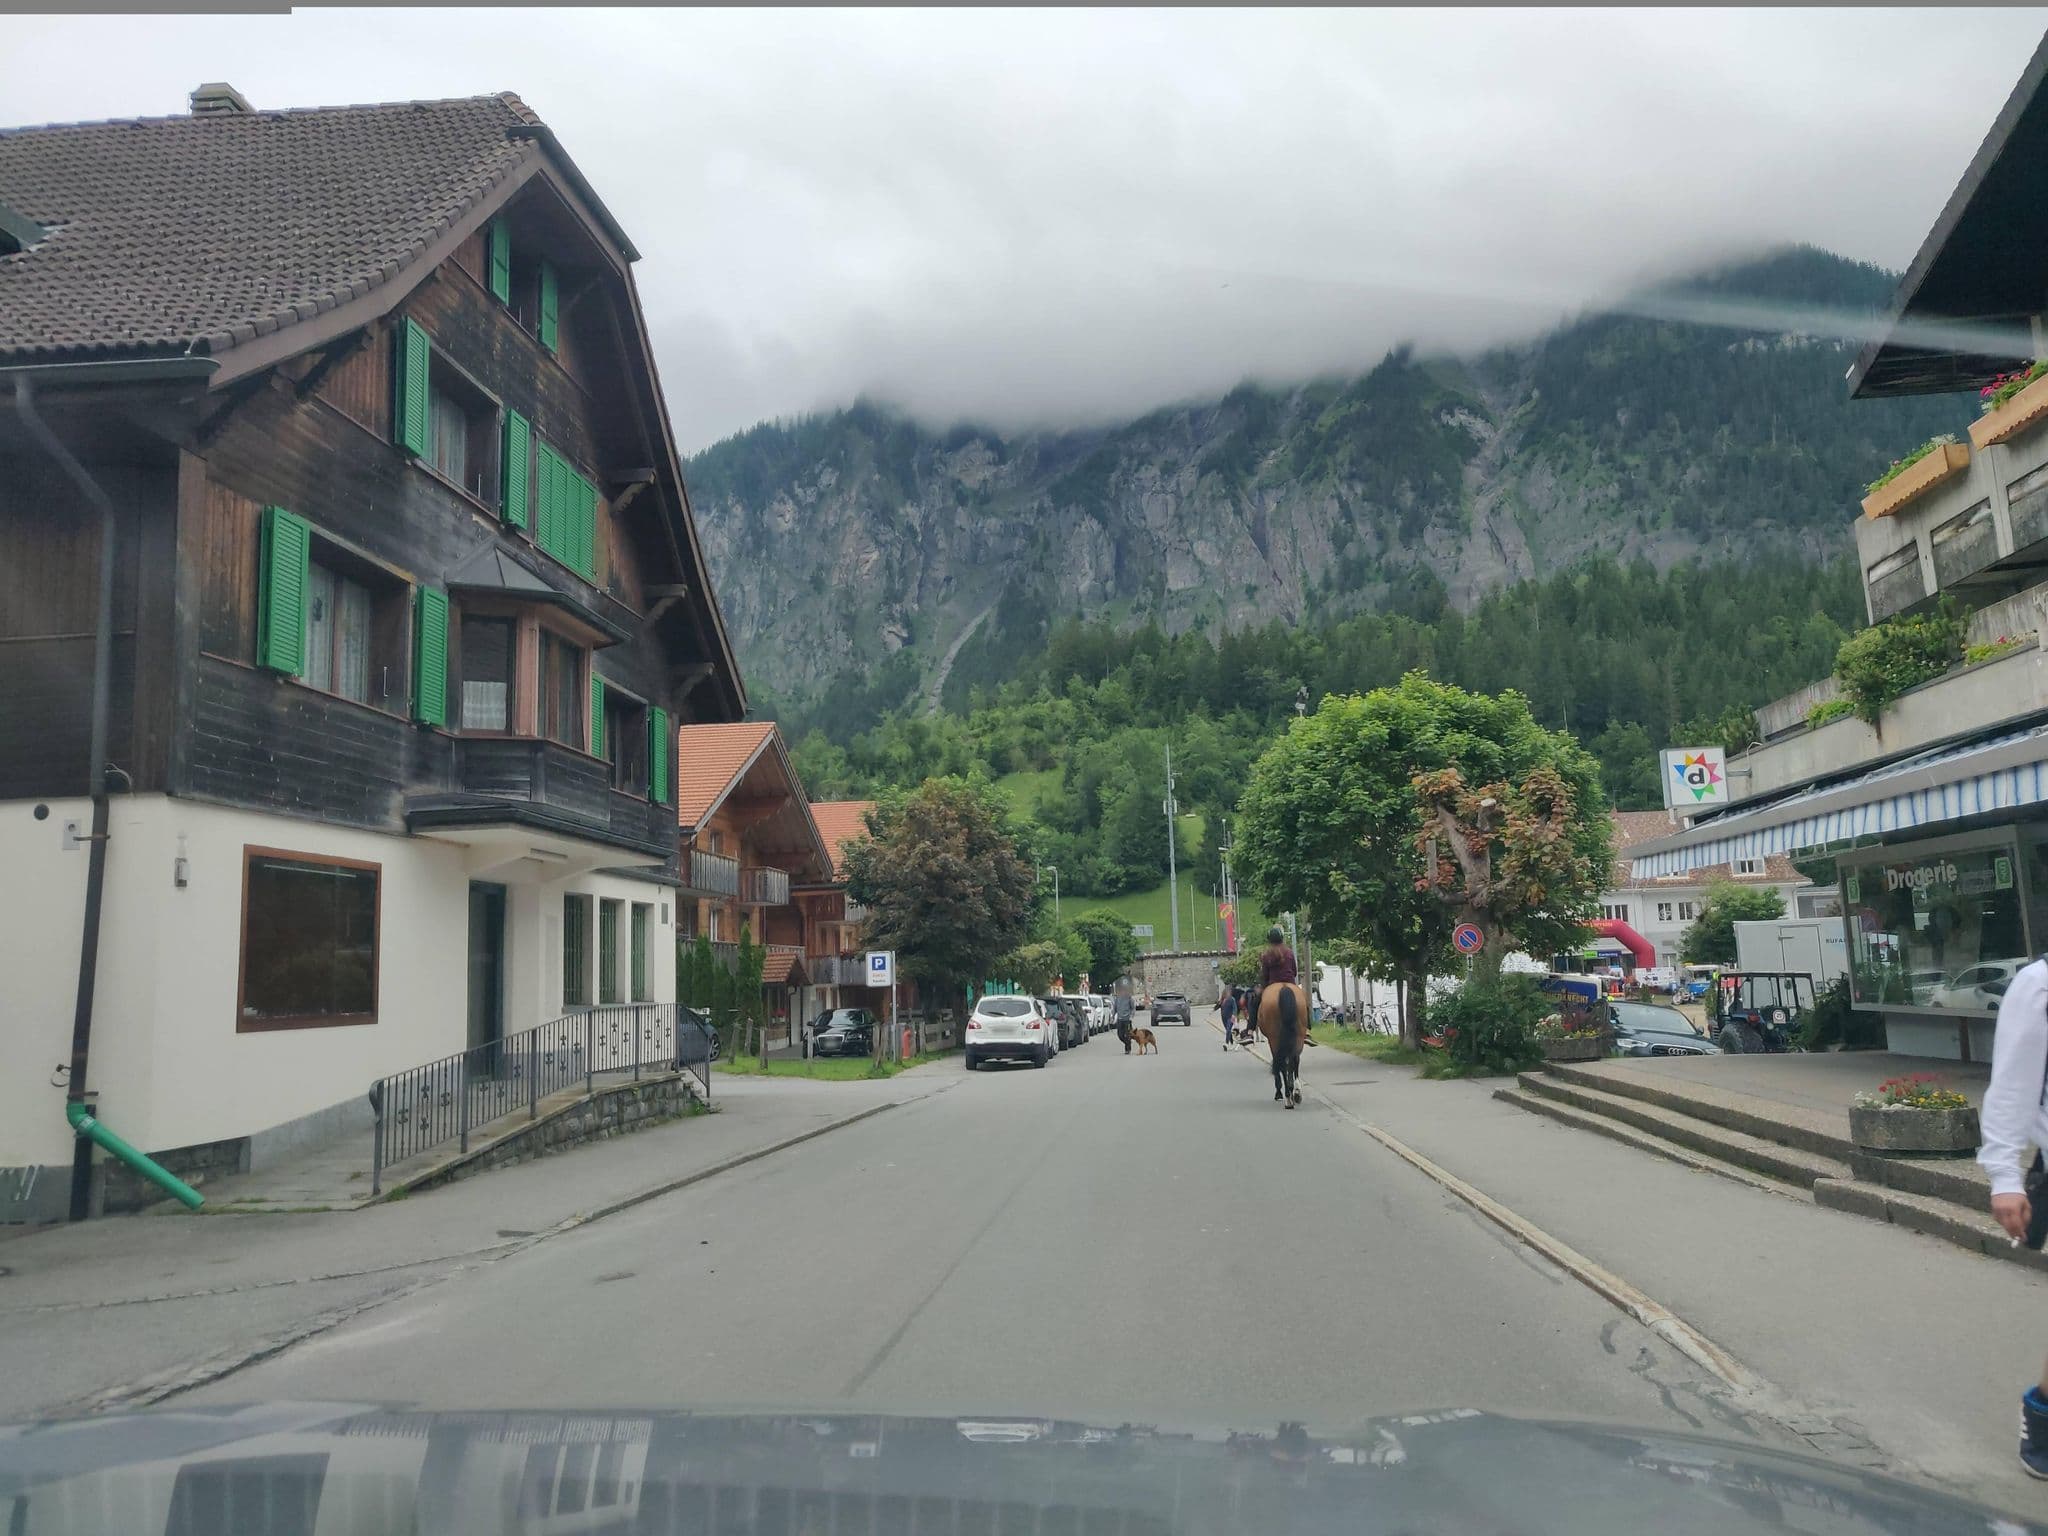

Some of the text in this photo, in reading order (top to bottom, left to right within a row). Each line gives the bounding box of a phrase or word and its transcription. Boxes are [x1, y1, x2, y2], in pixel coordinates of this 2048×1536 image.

[1687, 767, 1705, 785] d
[1887, 859, 1958, 891] Drogerie
[874, 958, 884, 969] P
